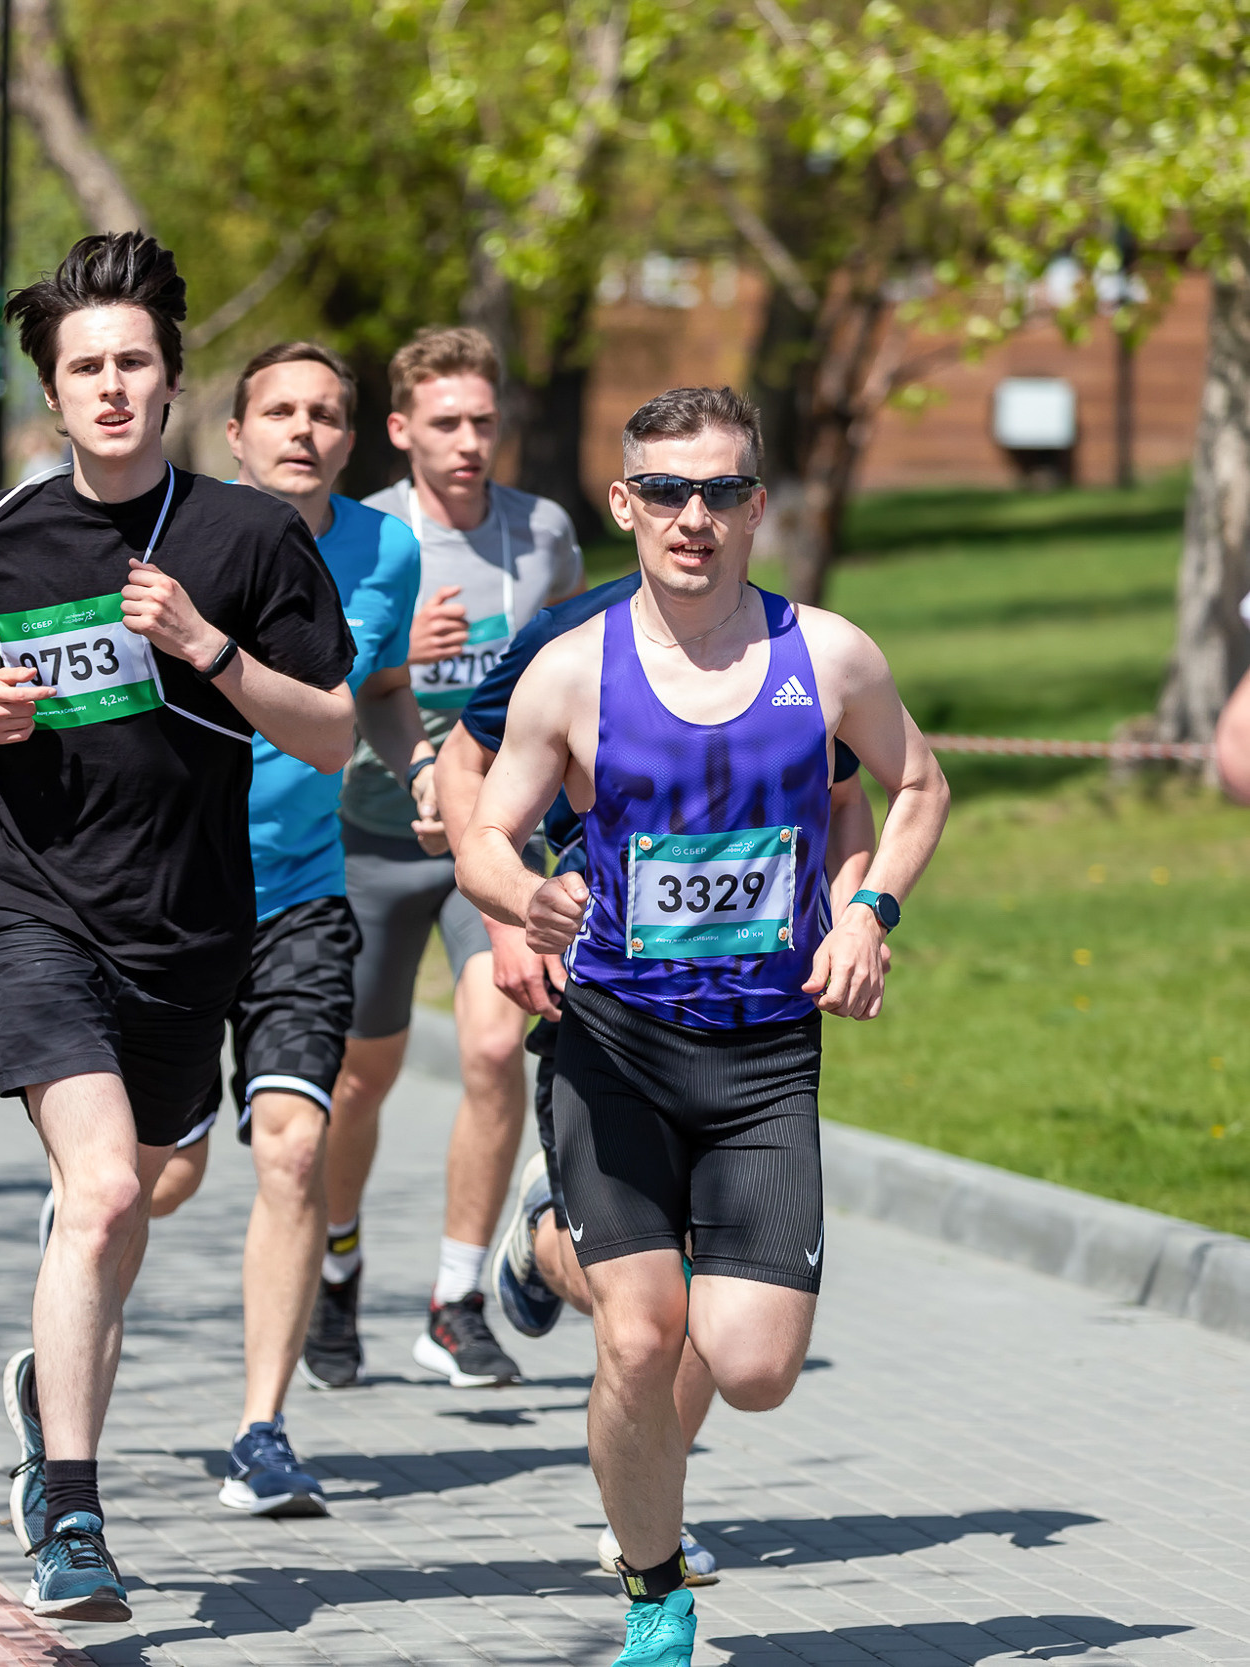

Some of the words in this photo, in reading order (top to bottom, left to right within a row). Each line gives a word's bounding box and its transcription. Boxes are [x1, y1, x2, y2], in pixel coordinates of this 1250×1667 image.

[31, 620, 53, 629] СБЕР
[771, 692, 814, 707] adidas
[683, 847, 707, 855] СБЕР
[657, 871, 765, 913] 3329
[736, 928, 749, 939] 10
